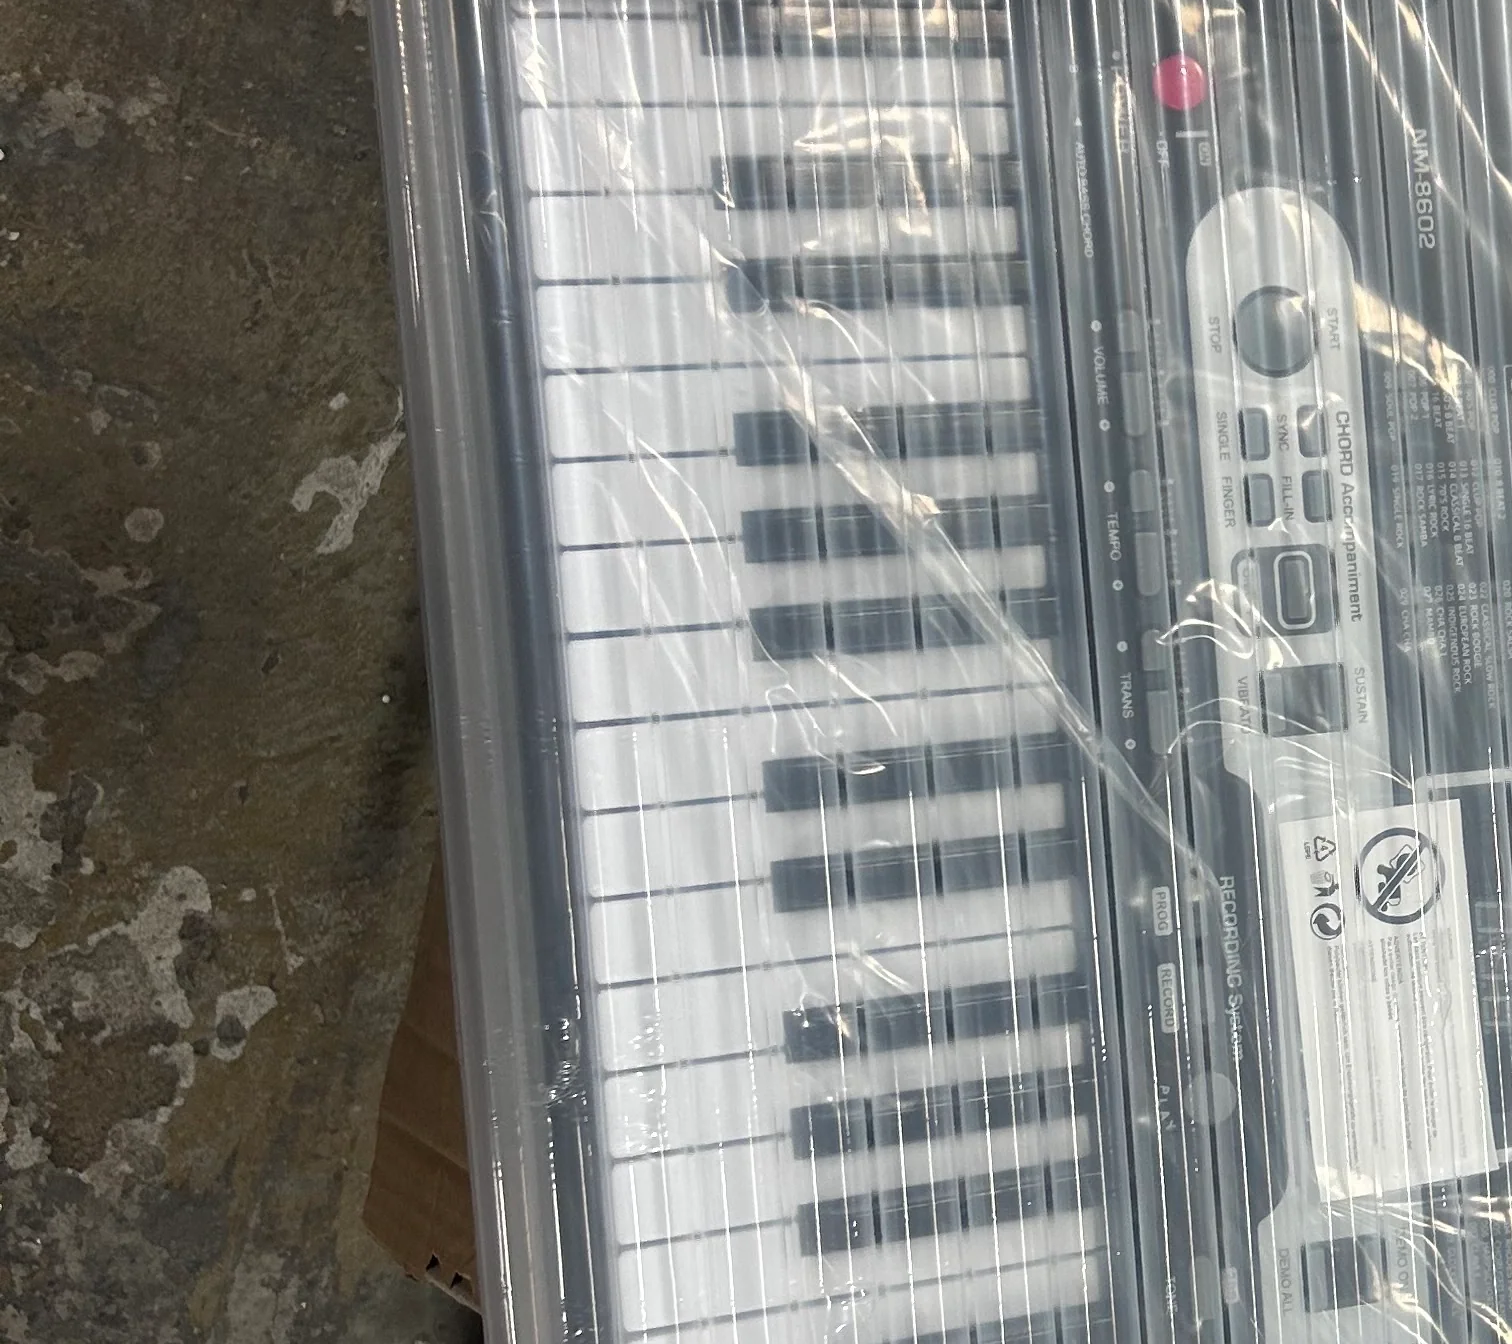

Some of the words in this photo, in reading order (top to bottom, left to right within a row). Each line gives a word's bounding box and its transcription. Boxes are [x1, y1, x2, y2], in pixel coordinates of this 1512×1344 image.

[1154, 140, 1169, 169] OFF
[1410, 127, 1435, 250] NM-8602
[1080, 212, 1094, 259] CHORD
[1207, 316, 1222, 355] STOP
[1326, 306, 1340, 351] START
[1092, 346, 1108, 406] VOLUME
[1407, 392, 1417, 412] POP
[1419, 392, 1429, 411] POP
[1432, 404, 1442, 429] BEAT
[1215, 411, 1231, 461] SINGLE
[1275, 413, 1290, 453] SYNC
[1335, 409, 1354, 477] CHORD
[1445, 420, 1454, 445] BEAT
[1413, 463, 1423, 482] 017
[1424, 462, 1433, 481] 016
[1436, 462, 1445, 480] 015
[1448, 461, 1457, 480] 014
[1219, 475, 1236, 529] FINGER
[1279, 475, 1295, 521] FILL-IN
[1390, 486, 1401, 522] SINGLE
[1415, 484, 1426, 511] ROCK
[1425, 483, 1436, 511] LYRIC
[1449, 482, 1461, 533] CLASSICAL
[1459, 481, 1470, 517] SINGLE
[1428, 511, 1437, 539] ROCK
[1439, 506, 1449, 532] ROCK
[1462, 518, 1471, 531] 16
[1104, 512, 1120, 562] TEMPO
[1394, 522, 1404, 549] ROCK
[1463, 531, 1474, 556] BEAT
[1338, 481, 1364, 623] Accompaniment
[1453, 543, 1463, 567] BEAT
[1444, 584, 1453, 602] 025
[1456, 583, 1465, 601] 024
[1400, 609, 1410, 631] CHA
[1435, 607, 1445, 628] CHA
[1468, 604, 1479, 631] ROCK
[1503, 601, 1512, 627] ROCK
[1401, 631, 1411, 653] CHA
[1436, 629, 1446, 651] CHA
[1446, 605, 1459, 666] INDIGENOUS
[1458, 605, 1470, 657] EUROPEAN
[1450, 667, 1461, 694] ROCK
[1462, 659, 1471, 685] ROCK
[1483, 655, 1493, 681] SLOW
[1118, 672, 1134, 719] TRANS
[1235, 674, 1252, 735] VIBRATO
[1352, 666, 1368, 724] SUSTAIN
[1154, 891, 1170, 932] PROG
[1216, 875, 1242, 989] RECORDING
[1160, 968, 1177, 1030] RECORD
[1222, 992, 1245, 1063] System
[1276, 1247, 1291, 1289] DEMO
[1280, 1291, 1292, 1316] ALL
